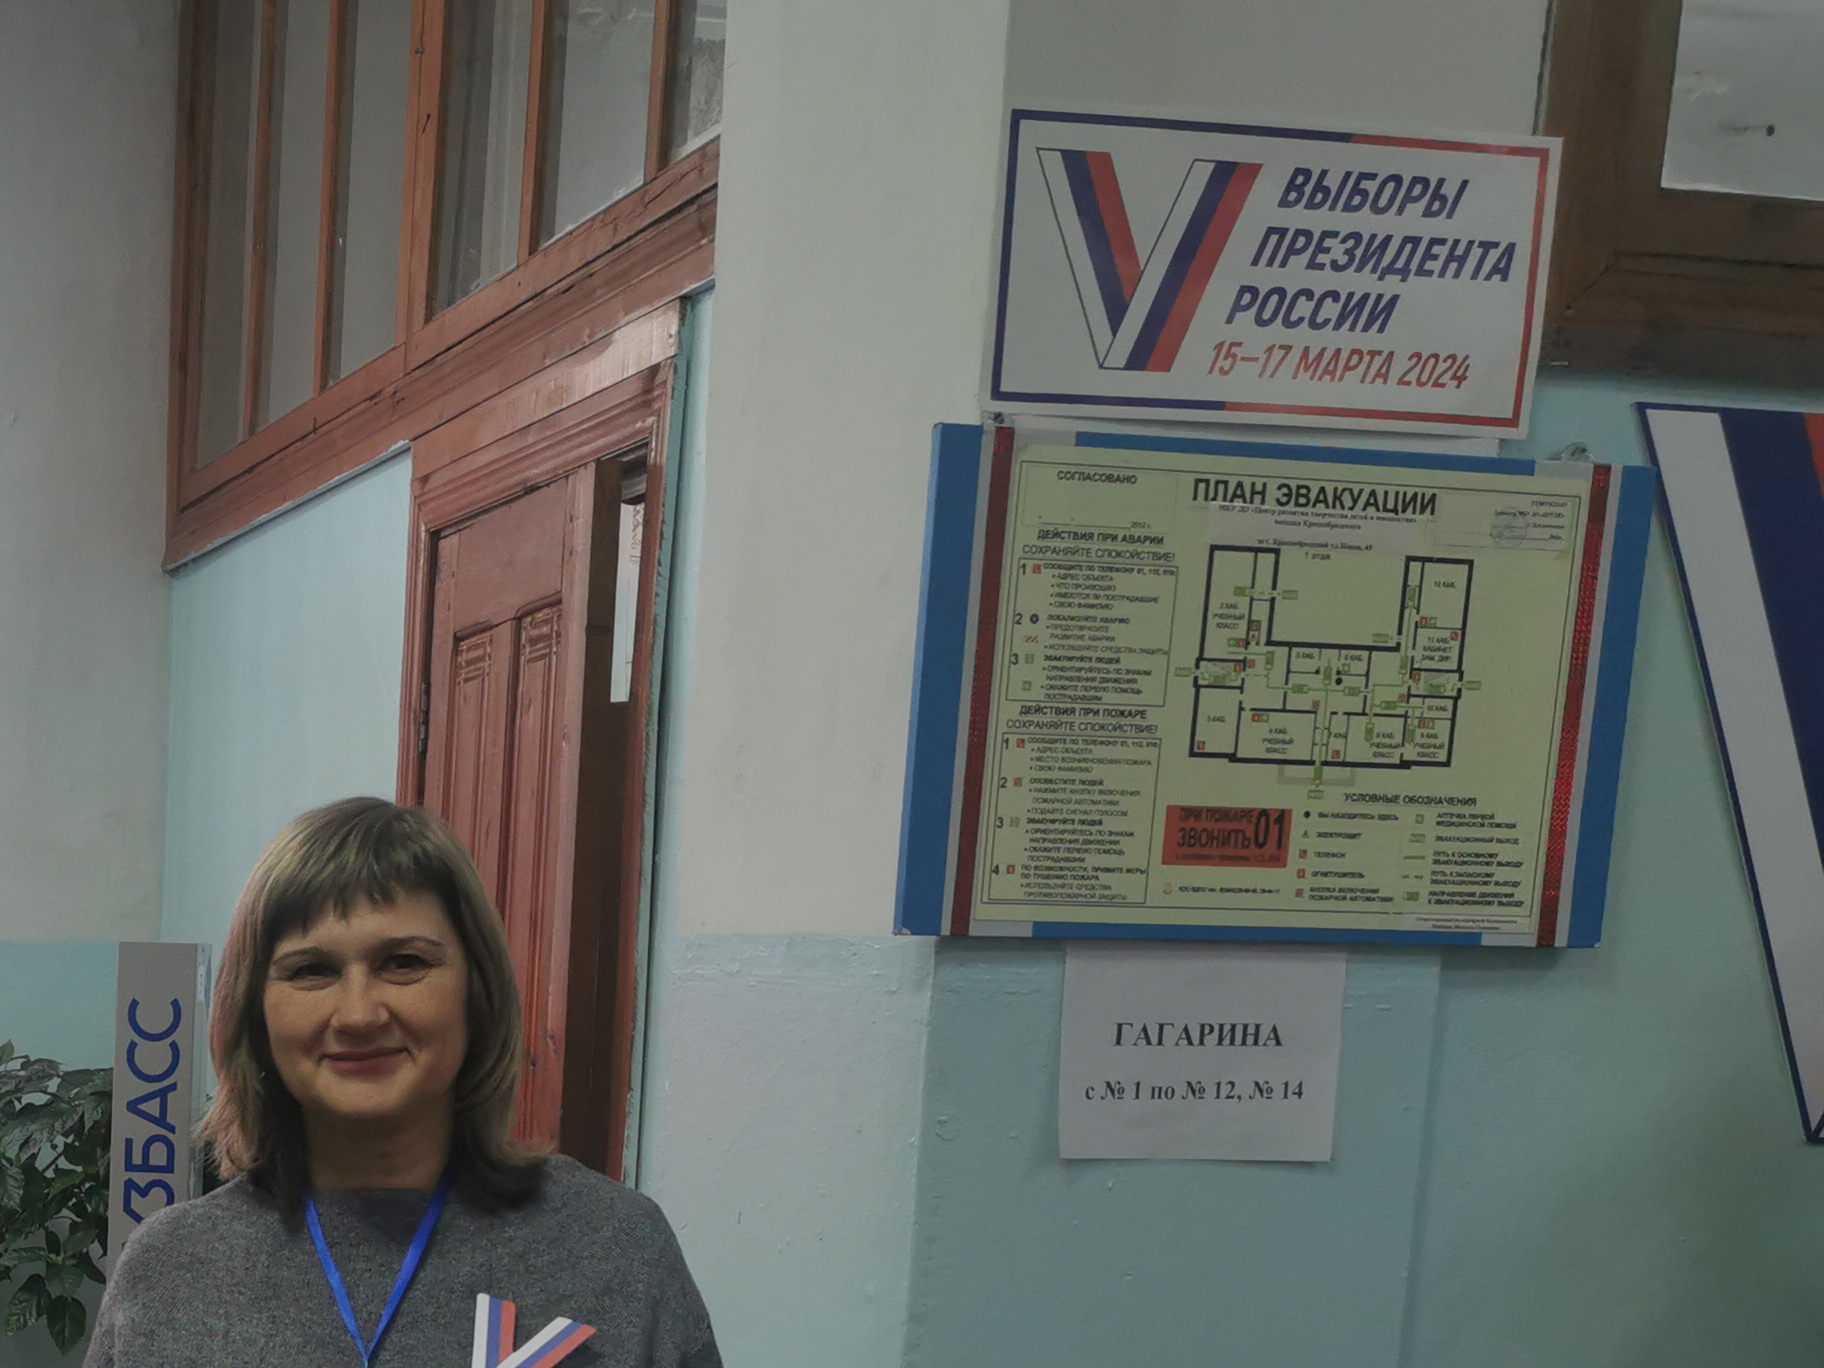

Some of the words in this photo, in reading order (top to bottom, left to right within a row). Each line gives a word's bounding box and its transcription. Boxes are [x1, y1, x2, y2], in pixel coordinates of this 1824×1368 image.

[1278, 167, 1471, 220] ВЫБОРЫ
[1250, 226, 1516, 284] ПРЕЗИДЕНТА
[1224, 284, 1401, 334] РОССИИ
[1294, 345, 1394, 386] МАРТА
[1396, 351, 1471, 391] 2024
[1057, 470, 1138, 484] СОГЛАСОВАНО
[1192, 478, 1267, 505] ПЛАН
[1276, 483, 1437, 516] ЭВАКУАЦИИ
[1037, 527, 1094, 541] ДЕЙСТВИЯ
[1097, 533, 1118, 542] ПРИ
[1121, 533, 1164, 545] АВАРИИ
[1023, 544, 1092, 557] СОХРАНЯЙТЕ
[1019, 705, 1075, 717] ДЕЙСТВИЯ
[1079, 708, 1099, 717] ПРИ
[1102, 709, 1147, 719] ПОЖАРЕ
[1006, 719, 1076, 731] СОХРАНЯЙТЕ
[1344, 793, 1400, 804] УСЛОВНЫЕ
[1403, 795, 1477, 807] ОБОЗНАЧЕНИЯ
[1177, 827, 1251, 849] ЗВОНИТЬ
[1254, 808, 1286, 850] 01
[1113, 1022, 1283, 1047] ГАГАРИНА
[1085, 1086, 1095, 1100] с
[1100, 1081, 1125, 1100] №
[1133, 1081, 1141, 1100] 1
[1150, 1085, 1175, 1101] по
[1181, 1081, 1206, 1100] №
[1214, 1081, 1242, 1103] 12,
[1249, 1081, 1274, 1100] №
[1281, 1081, 1304, 1100] 14
[123, 997, 182, 1248] ЗБАСС
